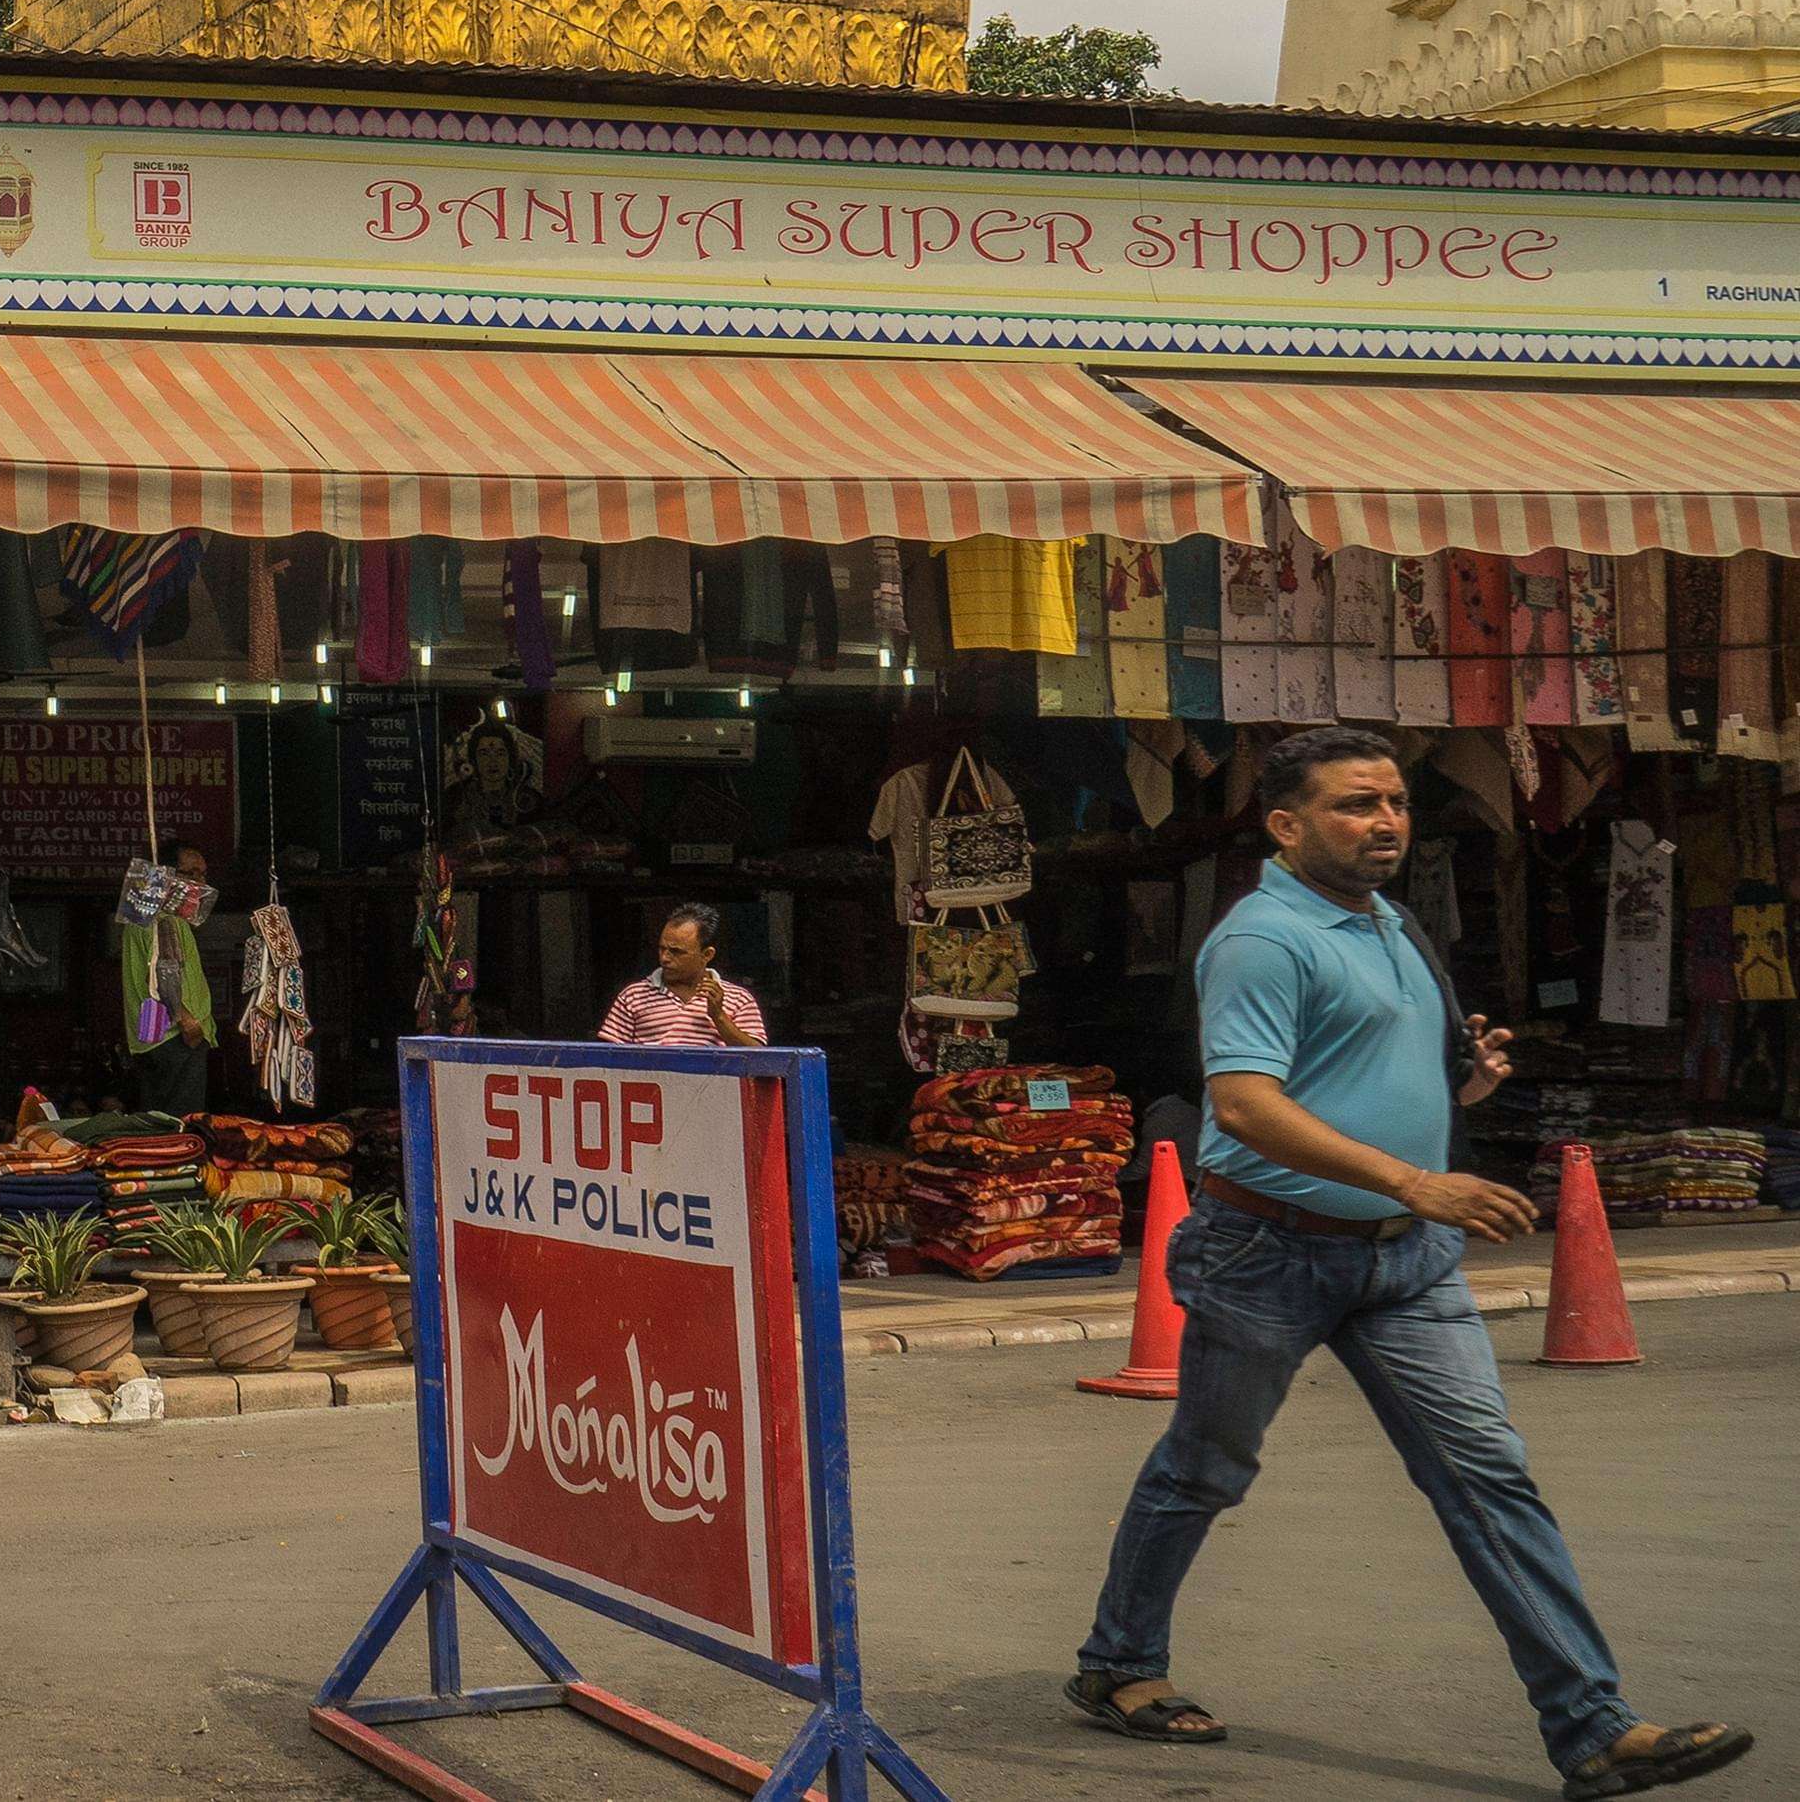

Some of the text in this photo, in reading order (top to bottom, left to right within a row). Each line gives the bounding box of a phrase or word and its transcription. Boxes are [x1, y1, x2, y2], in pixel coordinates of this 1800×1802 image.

[133, 162, 190, 171] SINCE 1982
[135, 223, 191, 235] BANIYA
[365, 179, 1558, 287] BANIYA SUPER SHOPPEE
[139, 237, 188, 248] GROUP
[1657, 277, 1669, 297] 1
[67, 724, 183, 752] PRICE
[25, 755, 109, 785] SUPER
[114, 756, 227, 787] SHOPPEE
[111, 790, 142, 807] TO
[2, 809, 61, 823] CREDIT
[65, 809, 121, 823] CARDS
[123, 809, 203, 824] ACCEPTED
[13, 826, 177, 843] FACILITIES
[484, 1073, 665, 1174] STOP
[464, 1167, 715, 1249] J&K POLICE
[706, 1387, 727, 1412] TM
